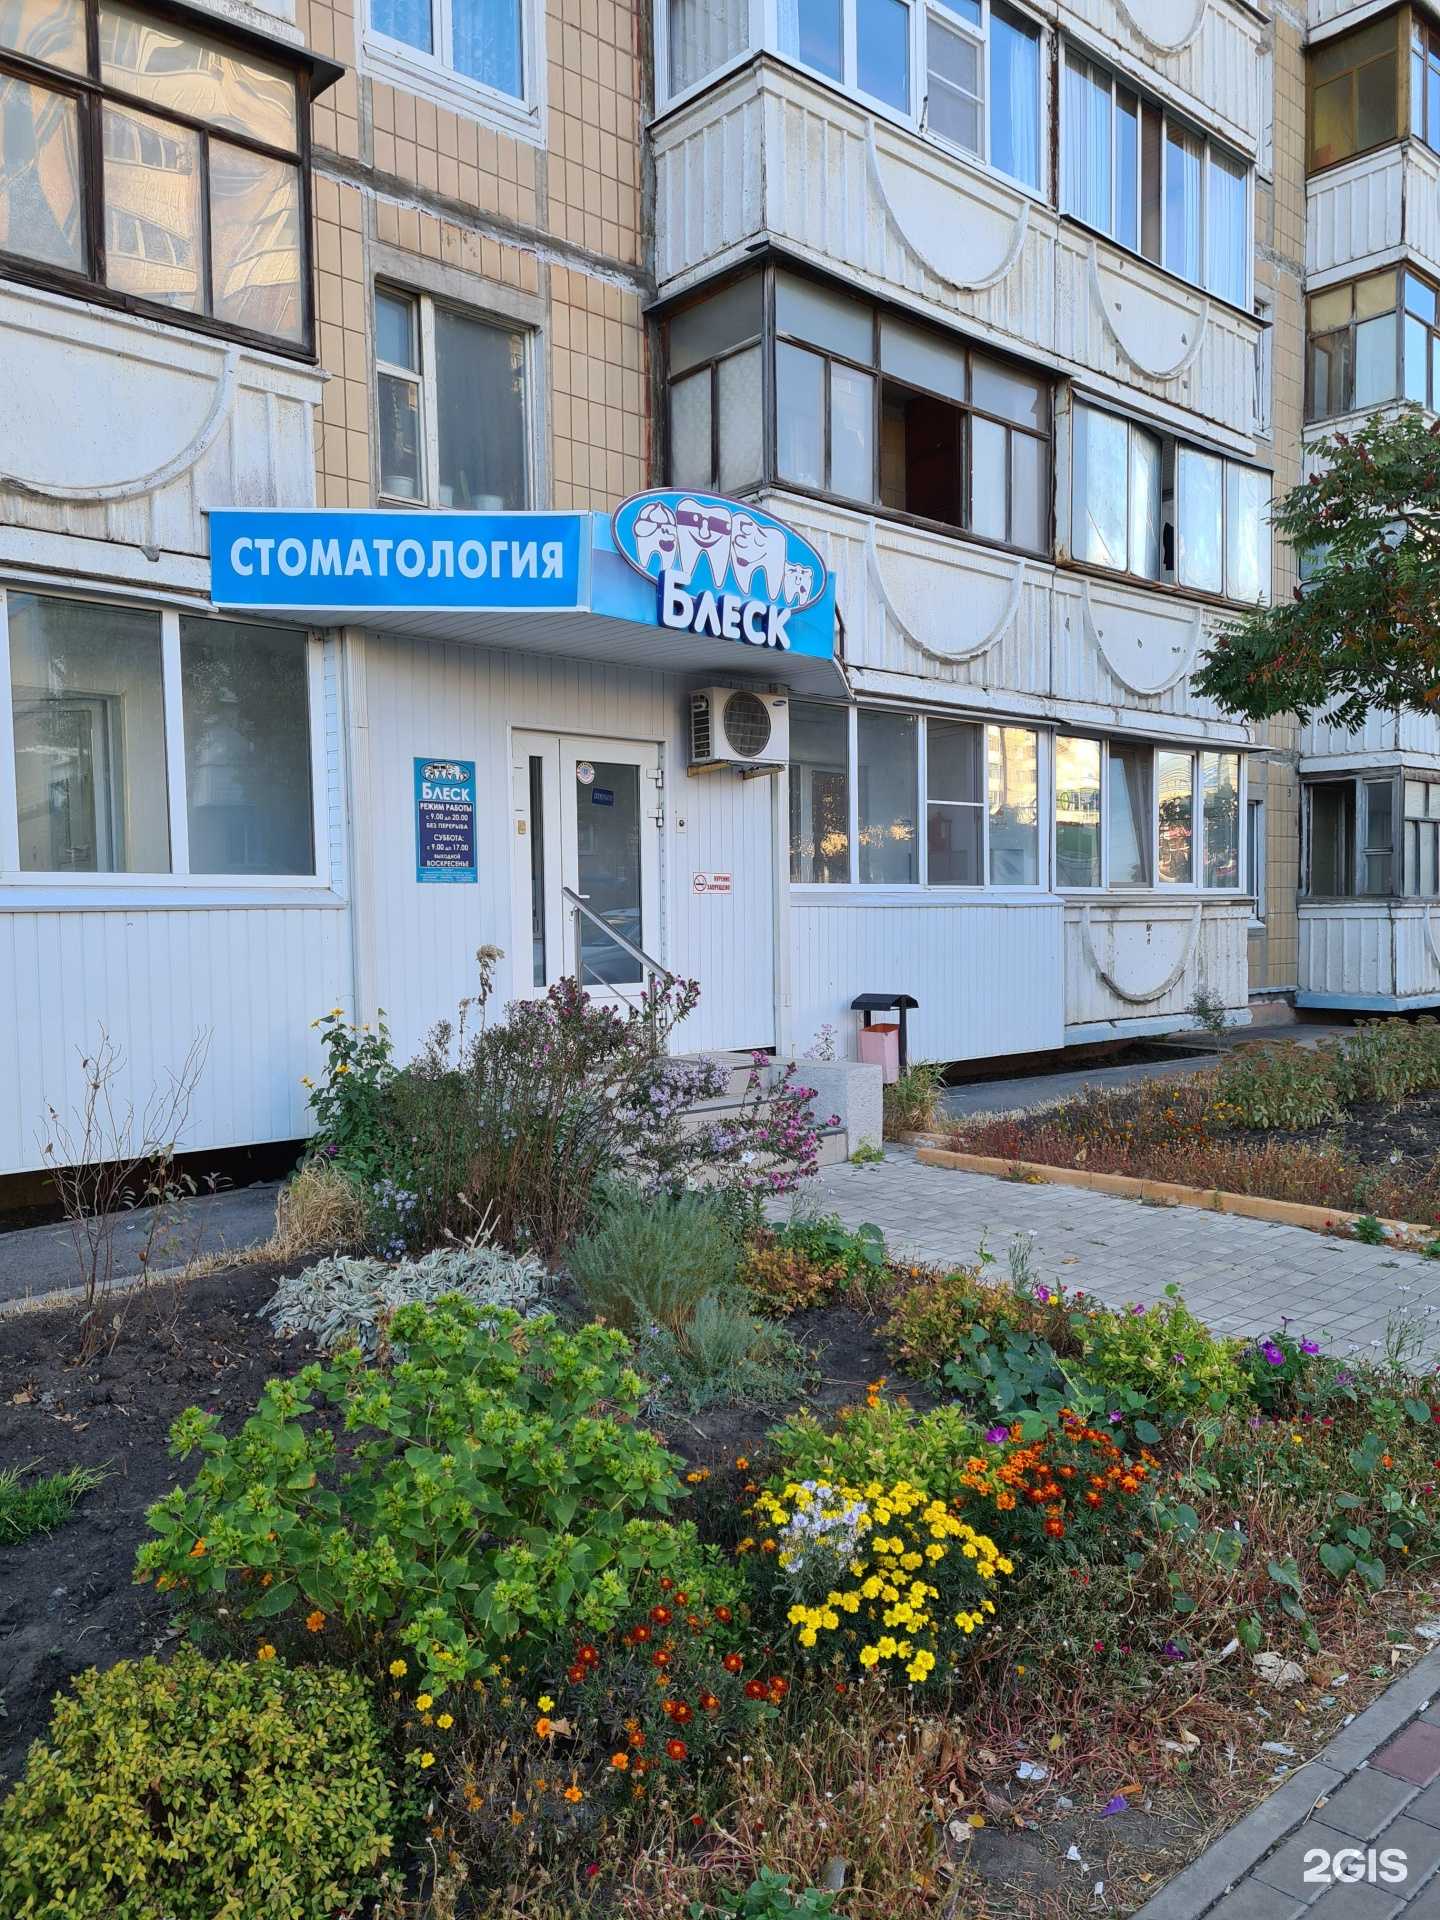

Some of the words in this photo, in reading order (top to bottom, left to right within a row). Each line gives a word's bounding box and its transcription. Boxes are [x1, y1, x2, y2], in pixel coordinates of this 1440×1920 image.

[230, 537, 563, 579] СТОМАТОЛОГИЯ
[659, 568, 792, 650] БЛЕСК
[422, 782, 470, 801] БЛЕСК
[420, 802, 444, 811] РЕЖИМ
[445, 804, 472, 812] РАБОТЫ
